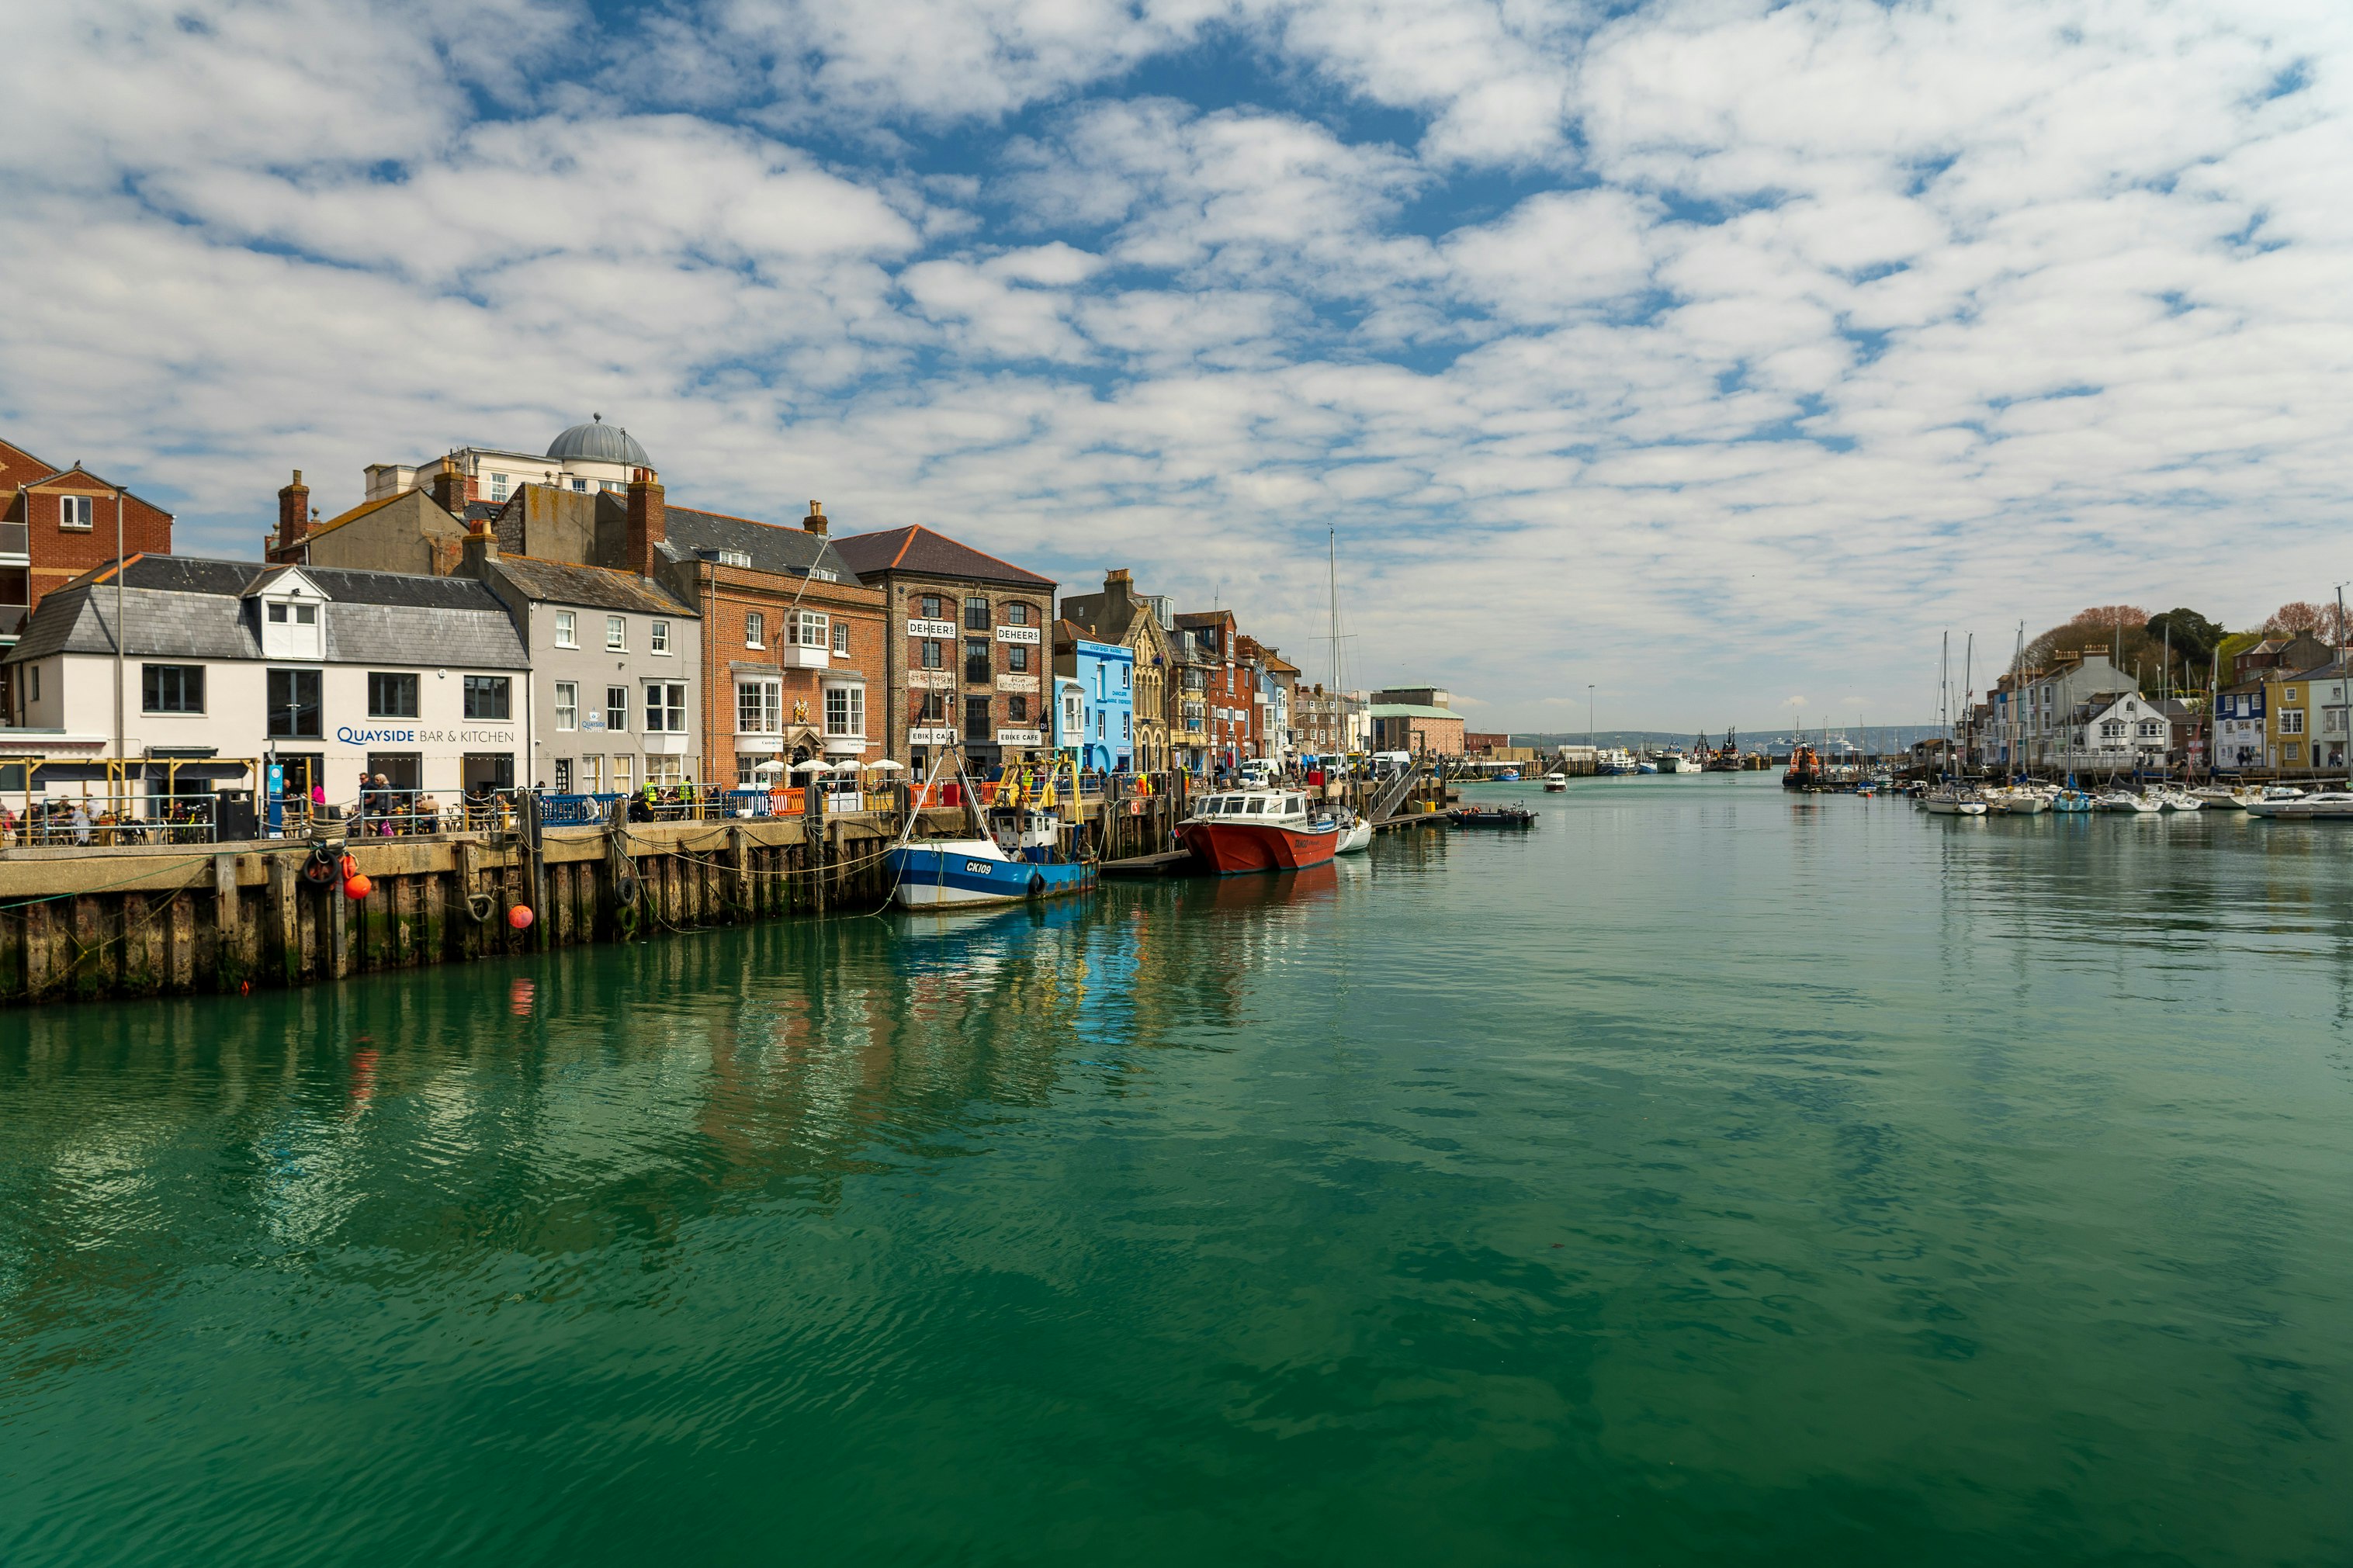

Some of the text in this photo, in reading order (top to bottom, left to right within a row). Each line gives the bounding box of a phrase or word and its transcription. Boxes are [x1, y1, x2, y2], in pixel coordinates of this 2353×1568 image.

[999, 630, 1038, 640] DEHEERS
[582, 721, 605, 729] QUAYSIDE
[337, 726, 514, 746] QUAYSIDE BAR & KITCHEN
[966, 862, 992, 875] CK109
